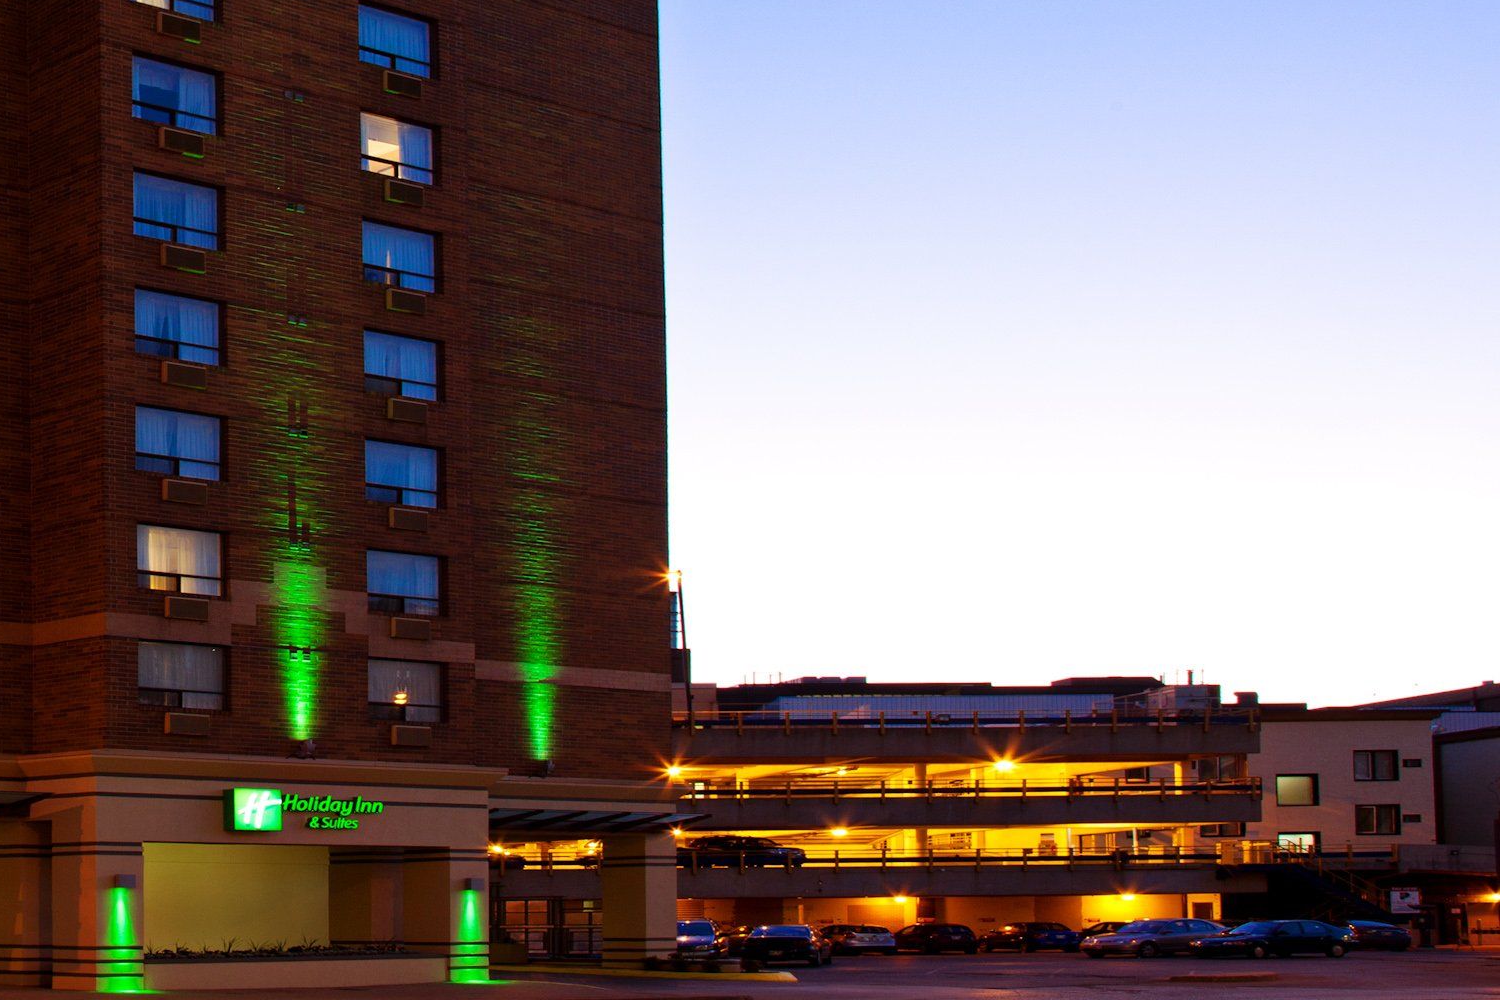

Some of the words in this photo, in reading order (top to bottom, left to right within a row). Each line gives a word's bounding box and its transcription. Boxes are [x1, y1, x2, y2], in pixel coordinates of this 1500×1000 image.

[283, 794, 353, 816] Holiday
[355, 796, 384, 813] Inn
[309, 816, 319, 828] &
[321, 816, 358, 829] Suites
